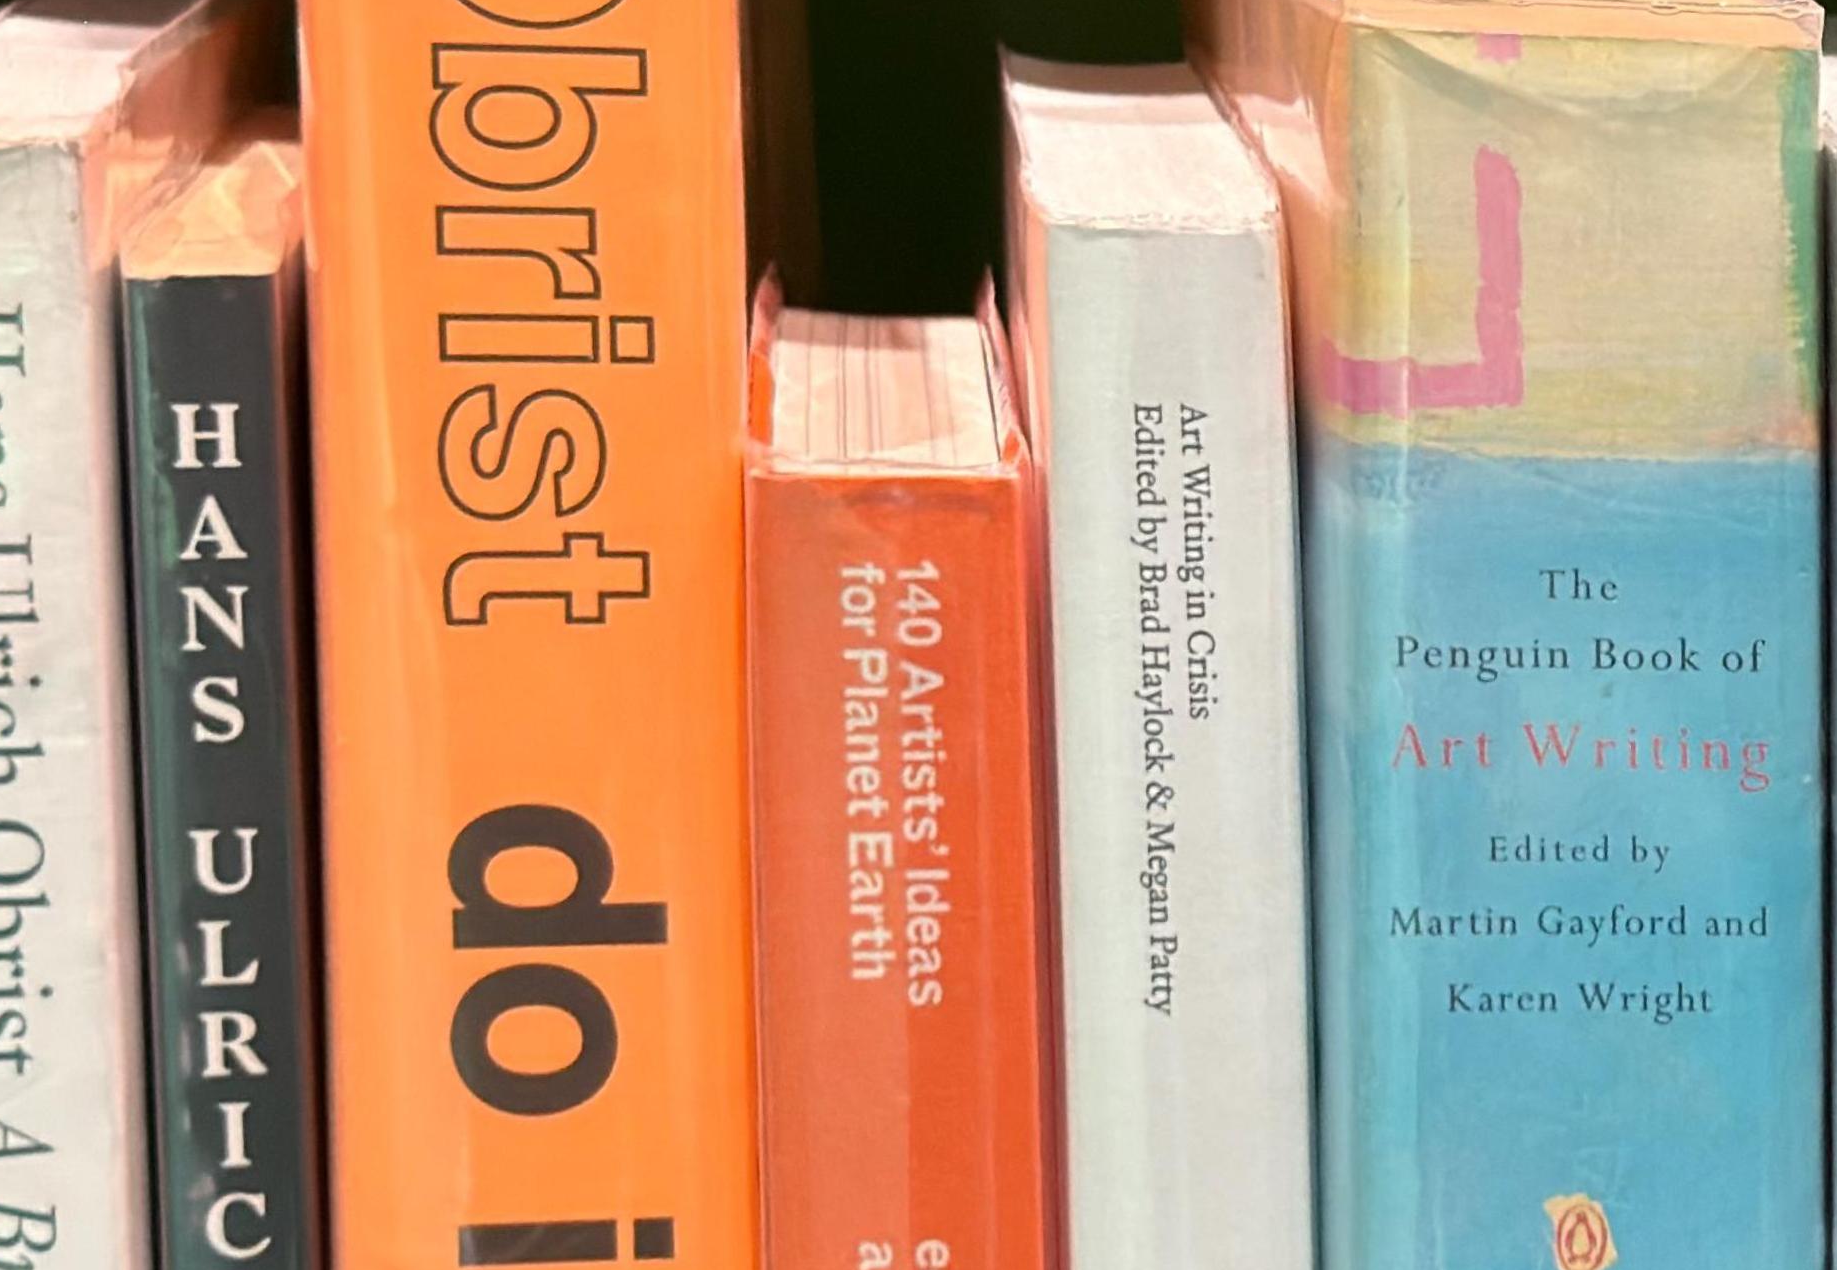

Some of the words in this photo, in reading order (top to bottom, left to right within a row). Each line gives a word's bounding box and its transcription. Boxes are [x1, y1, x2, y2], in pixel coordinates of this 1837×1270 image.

[1134, 403, 1166, 506] Edited
[172, 403, 248, 742] HANS
[1178, 464, 1216, 582] Writing
[897, 557, 941, 645] 140
[1539, 568, 1618, 602] The
[1132, 644, 1174, 771] Haylock
[1186, 630, 1218, 720] Crisis
[1396, 635, 1569, 682] Penguin
[1592, 637, 1701, 671] Book
[1722, 638, 1766, 672] of
[844, 647, 889, 815] Planet
[1392, 723, 1494, 769] Art
[1523, 723, 1770, 792] Writing
[848, 831, 894, 979] Earth
[1141, 821, 1177, 925] Megan
[1489, 835, 1610, 863] Edited
[1631, 836, 1670, 872] by
[451, 803, 668, 1117] do
[905, 867, 951, 1005] Ideas
[1390, 906, 1517, 936] Martin
[1537, 905, 1687, 947] Gayford
[1705, 907, 1768, 937] and
[1447, 983, 1557, 1012] Karen
[1578, 982, 1712, 1023] Wright
